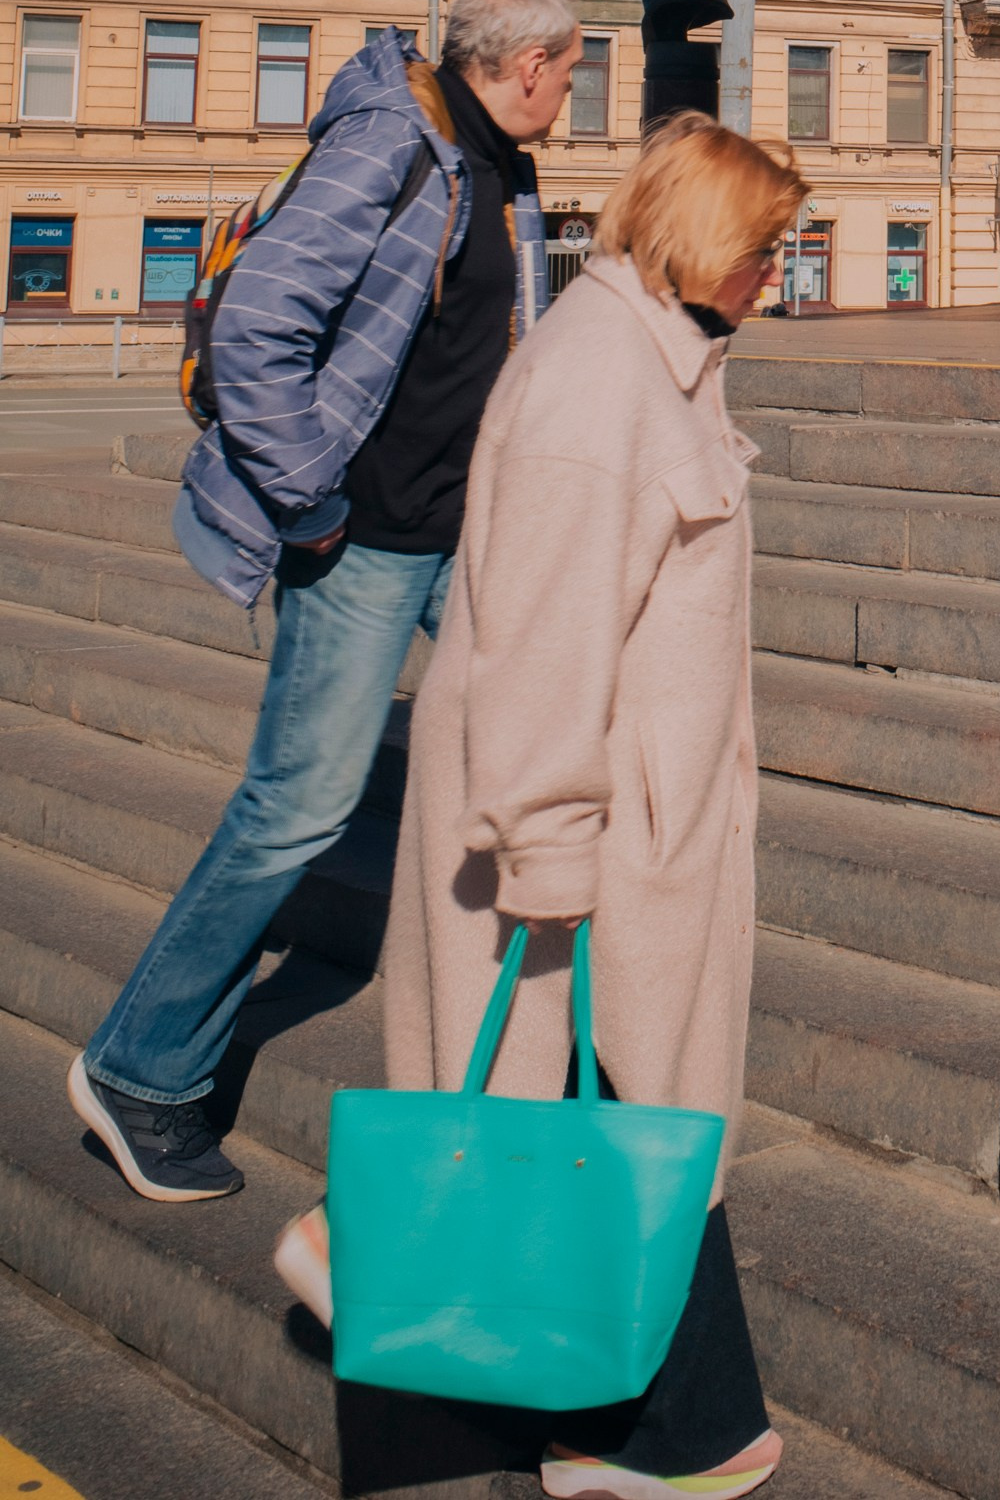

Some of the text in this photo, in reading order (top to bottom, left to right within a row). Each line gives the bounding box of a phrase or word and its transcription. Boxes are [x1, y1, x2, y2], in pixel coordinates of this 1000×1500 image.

[26, 190, 62, 202] ОПТИКА
[36, 228, 63, 237] ОЧКИ
[565, 225, 585, 238] 2.9
[146, 255, 172, 263] Подбор
[147, 272, 164, 280] ШБ
